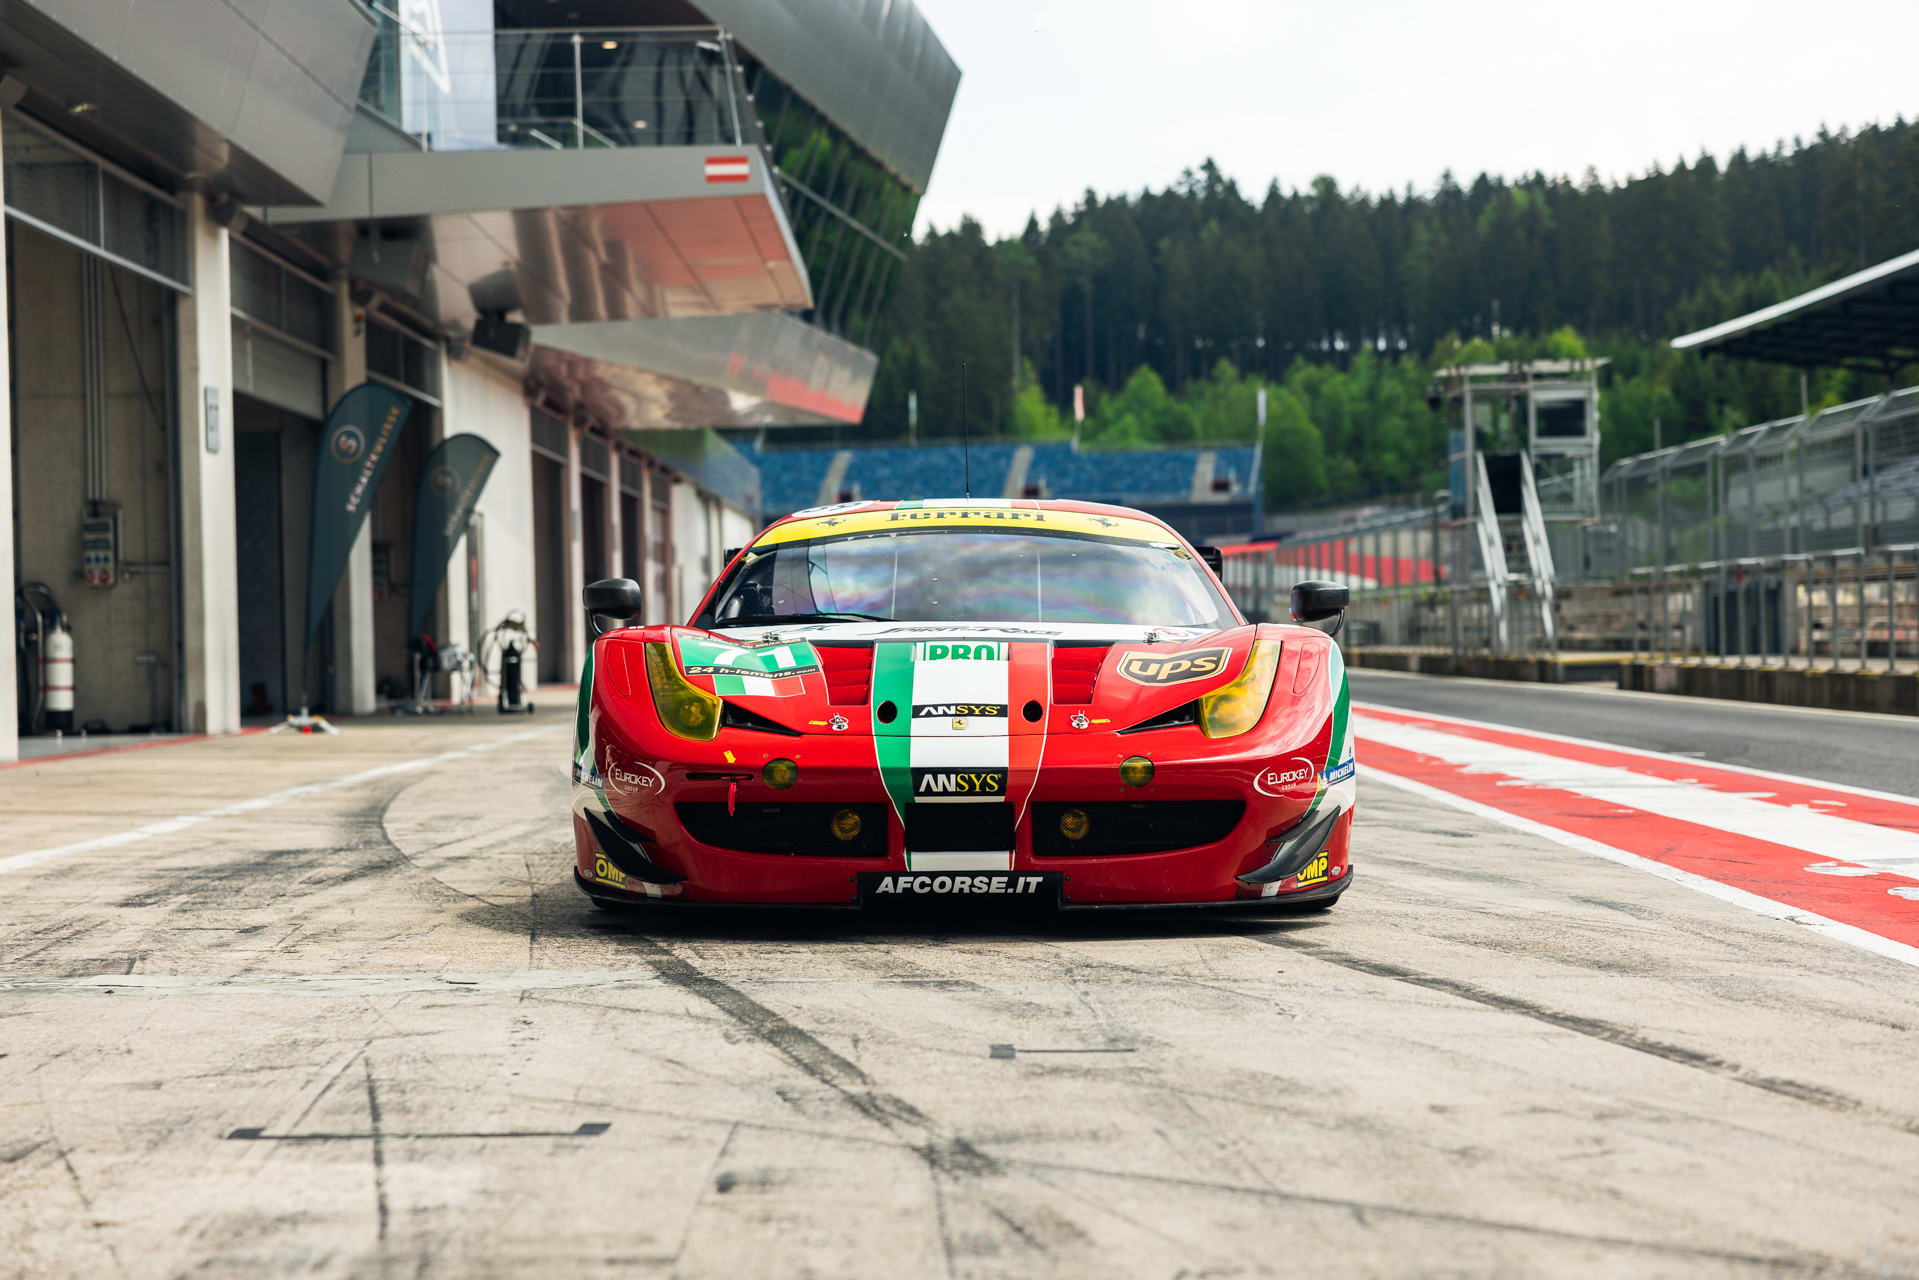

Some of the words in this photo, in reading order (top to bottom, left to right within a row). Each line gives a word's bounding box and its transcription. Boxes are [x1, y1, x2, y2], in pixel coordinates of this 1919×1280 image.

[888, 510, 1046, 522] Ferrari
[688, 665, 715, 674] 24
[1128, 656, 1218, 681] ups
[919, 705, 999, 716] ANSYS
[615, 768, 655, 788] EUROKEY
[1267, 767, 1309, 786] EUROKEY
[1328, 762, 1354, 781] MICHELIN
[919, 773, 1000, 792] ANSYS
[875, 875, 1044, 894] AFCORSE.IT
